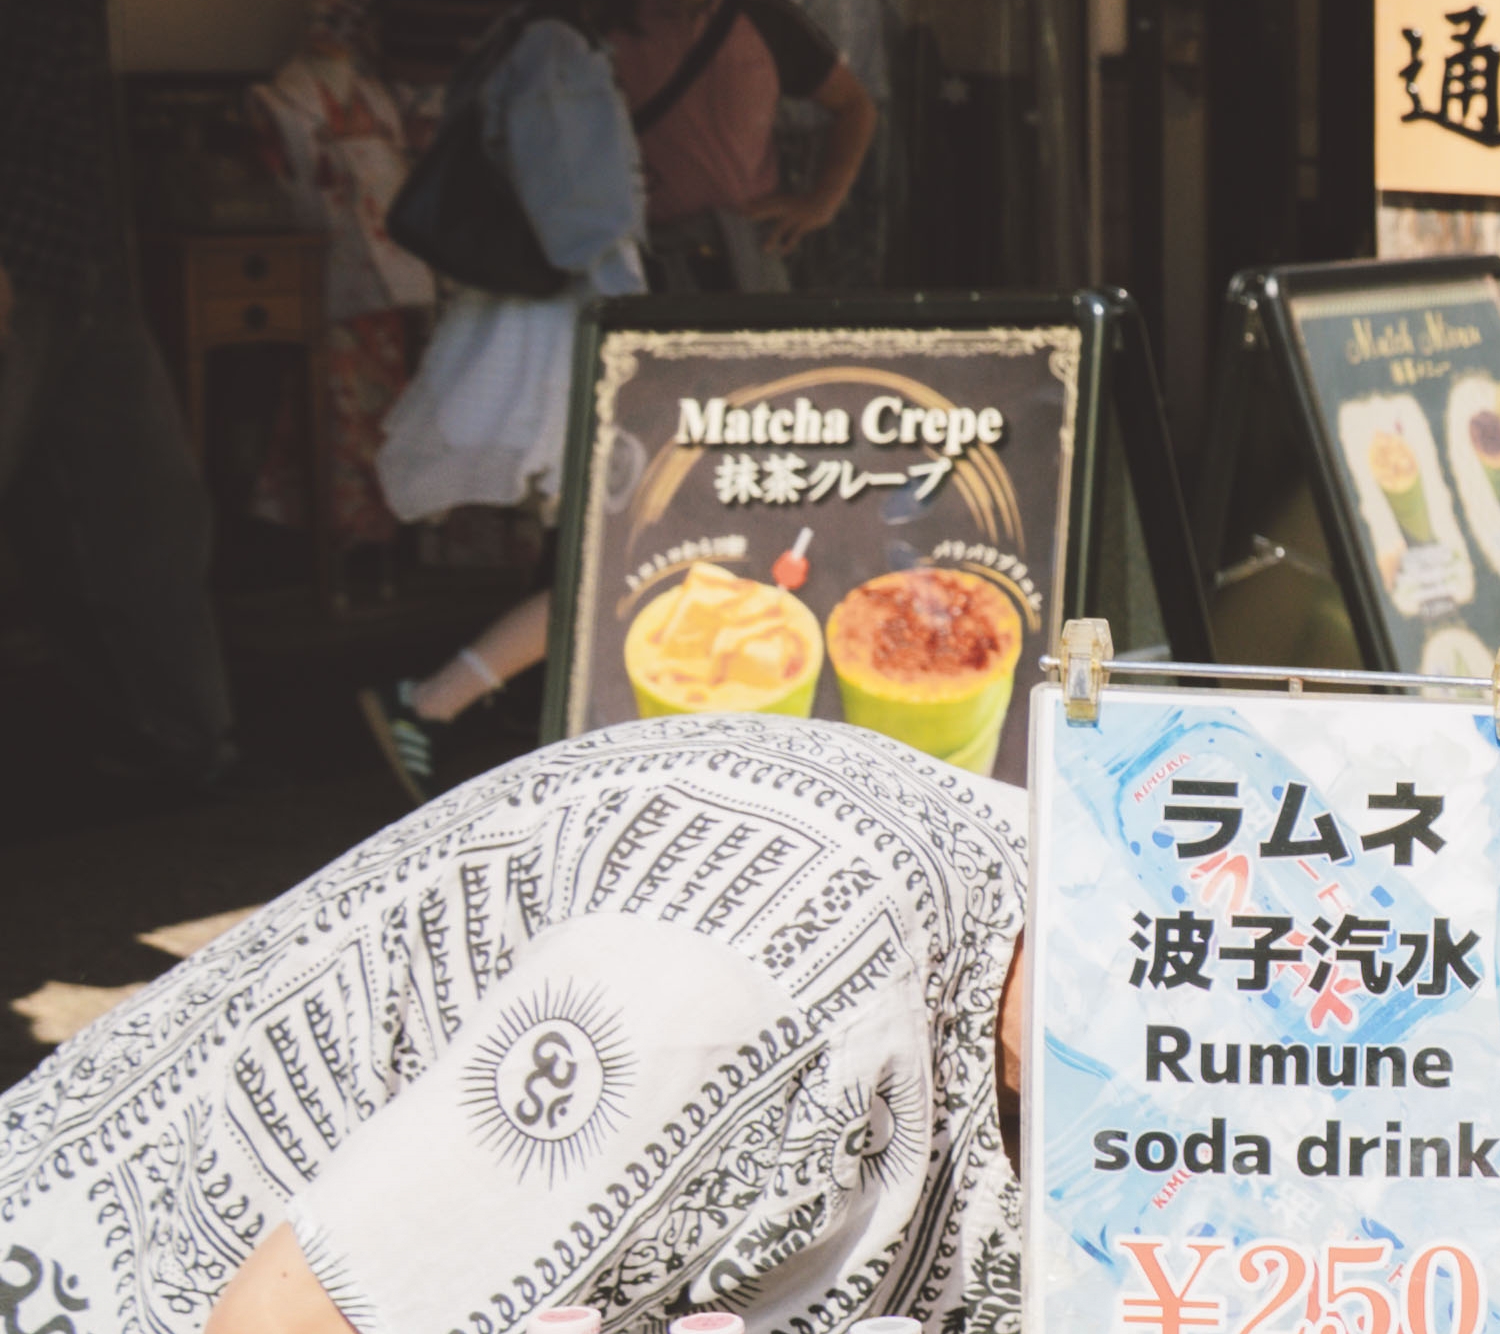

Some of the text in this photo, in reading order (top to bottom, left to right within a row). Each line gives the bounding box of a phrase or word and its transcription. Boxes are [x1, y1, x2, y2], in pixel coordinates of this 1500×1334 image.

[676, 395, 1004, 456] Matcha Crepe
[713, 452, 953, 506] 抹茶クレープ
[1163, 778, 1448, 867] ラムネ
[1128, 910, 1483, 997] 波子汽水
[1145, 1024, 1454, 1089] Rumune
[1092, 1117, 1500, 1179] soda drink
